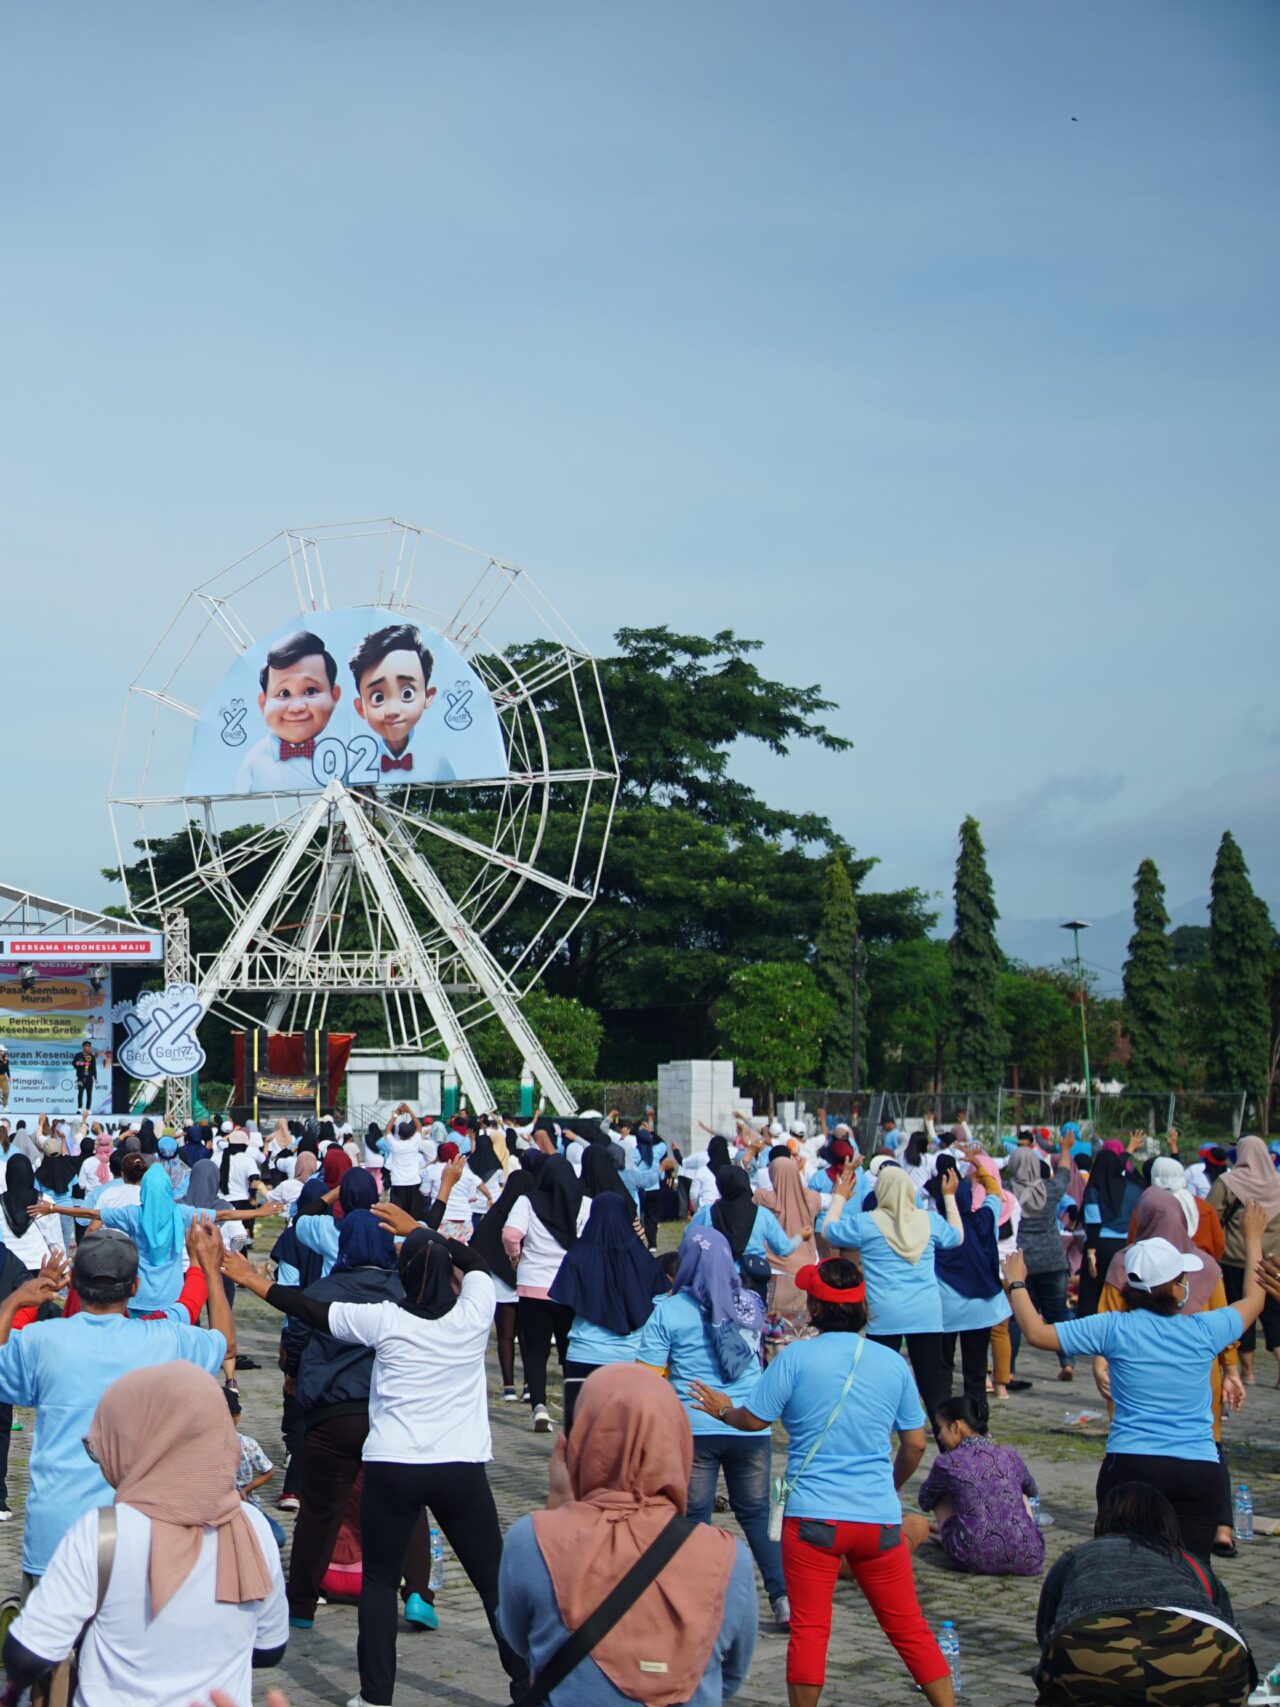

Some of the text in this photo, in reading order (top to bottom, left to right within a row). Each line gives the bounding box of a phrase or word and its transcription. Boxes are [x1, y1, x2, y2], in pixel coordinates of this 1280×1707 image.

[312, 734, 380, 787] 02
[15, 941, 146, 951] BERSAMA INDONESIA MAJU
[0, 986, 78, 996] Pasar Sembako
[21, 995, 53, 1004] Murah
[9, 1017, 72, 1026] Pemeriksaan
[52, 1026, 81, 1034] Gratis
[12, 1078, 46, 1086] Minggu,
